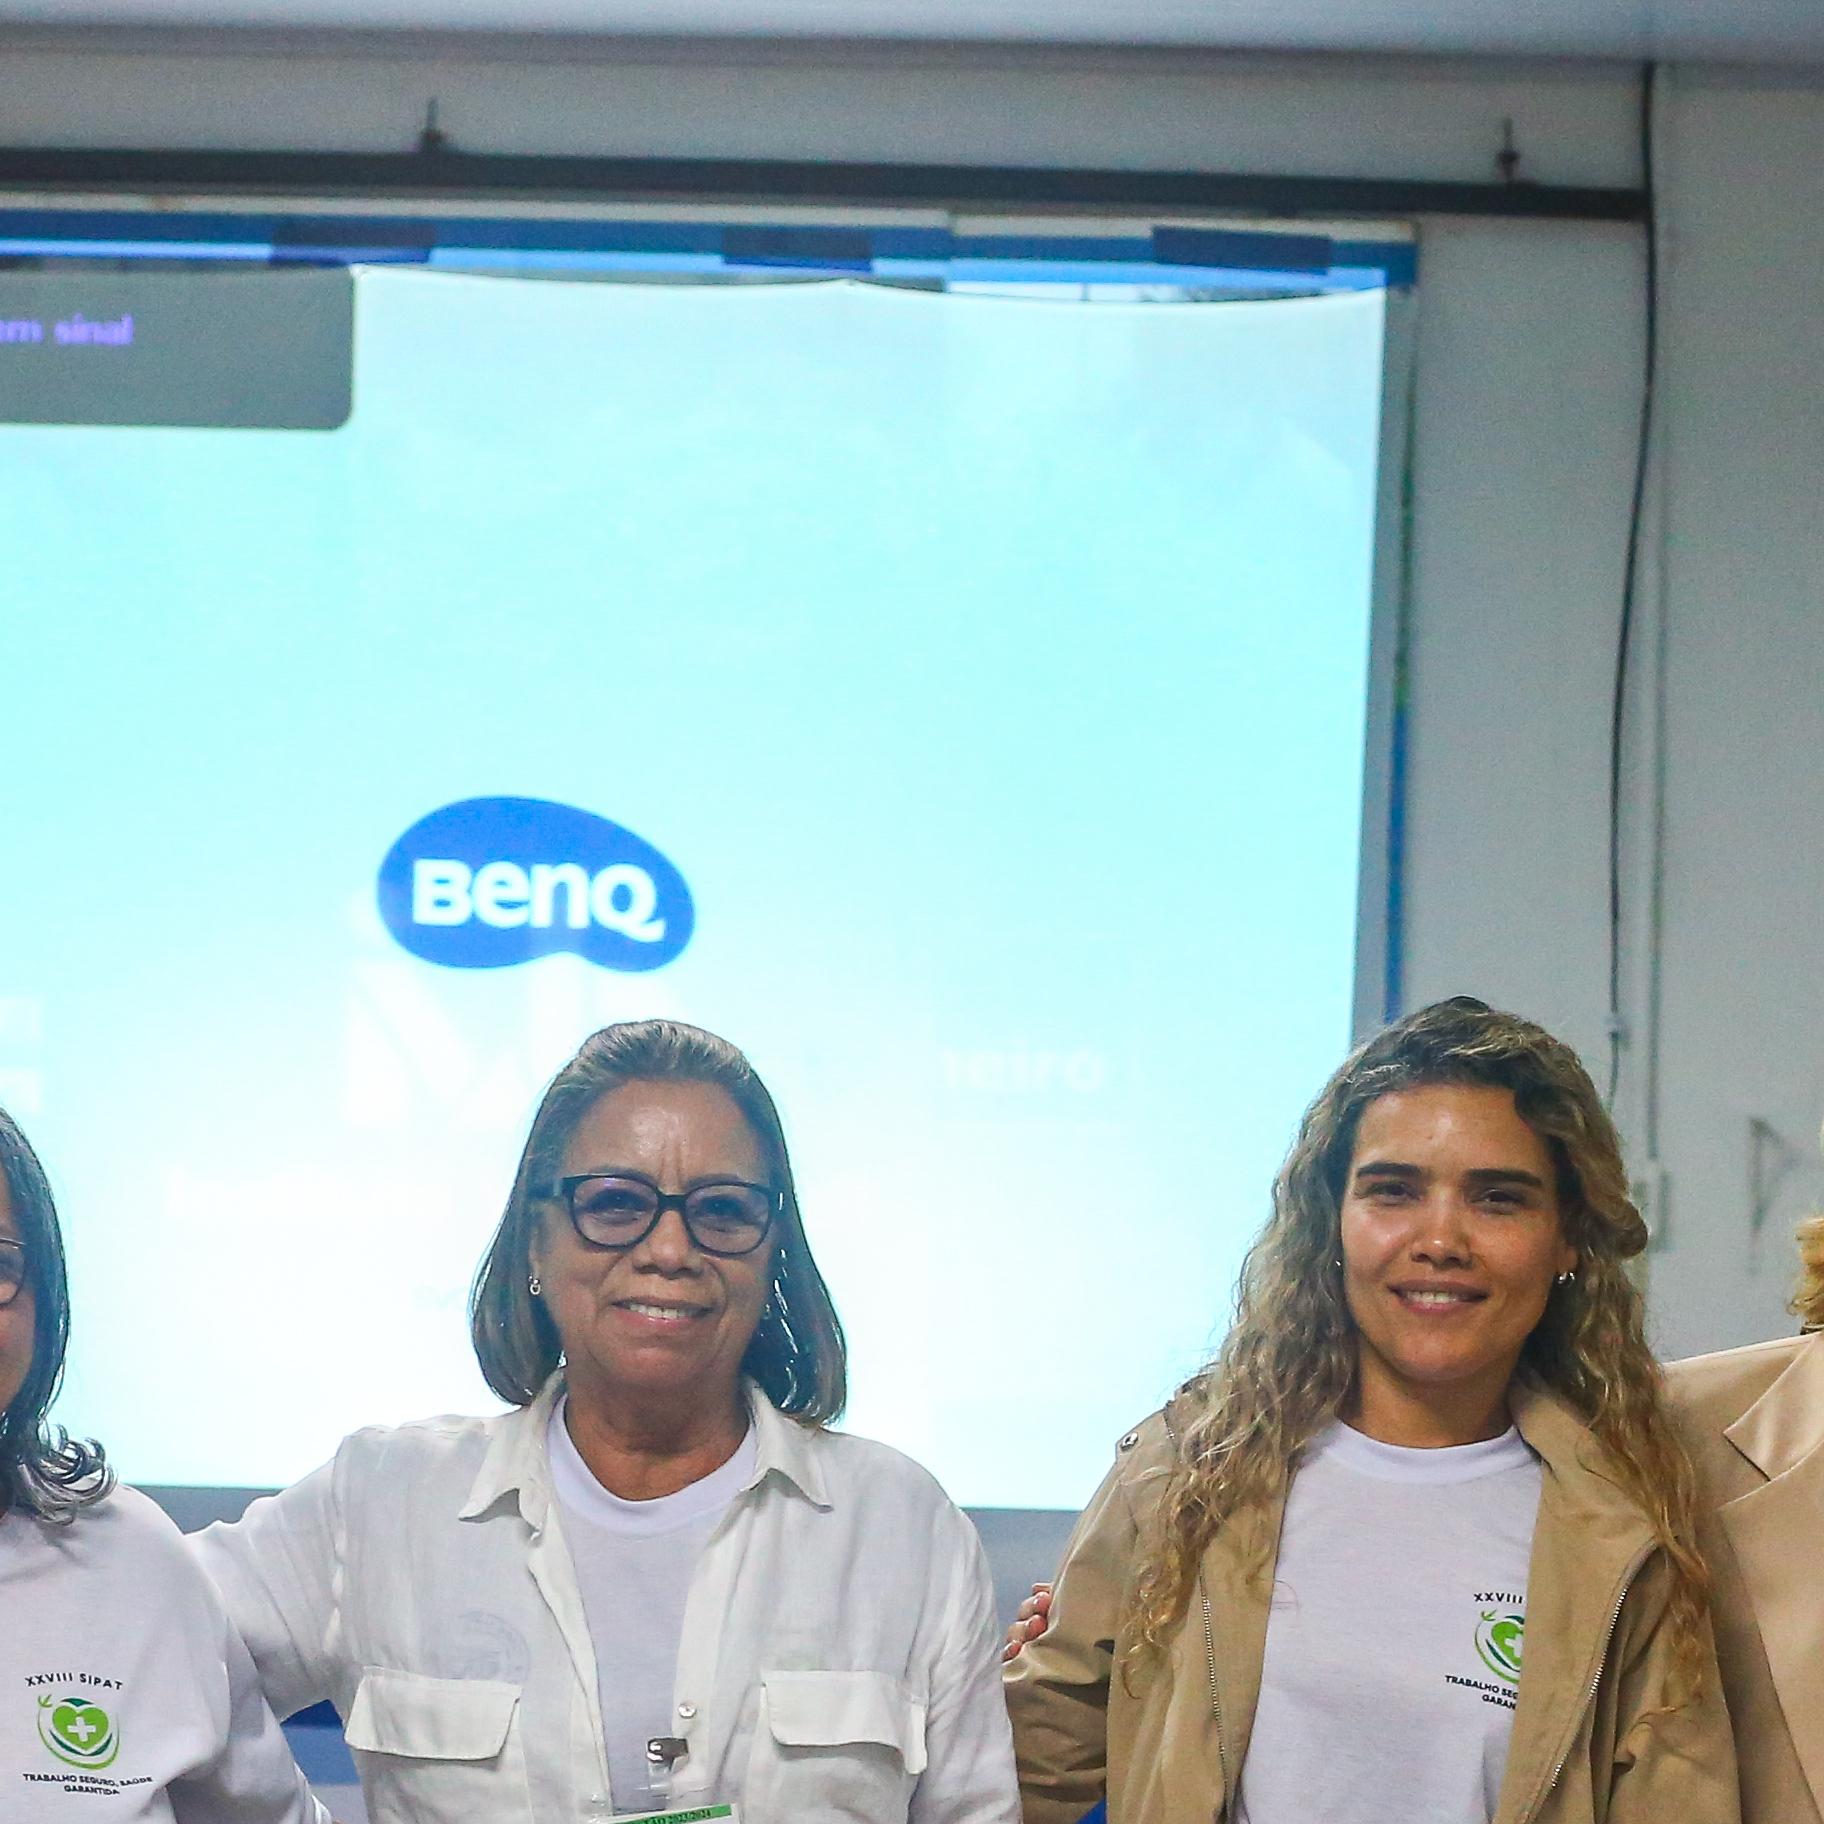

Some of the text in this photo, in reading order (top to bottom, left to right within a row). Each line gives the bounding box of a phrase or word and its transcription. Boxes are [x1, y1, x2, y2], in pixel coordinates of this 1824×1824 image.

[54, 313, 135, 346] sinal
[411, 857, 668, 944] BenQ
[1474, 1592, 1523, 1604] XXVIII
[24, 1672, 124, 1690] XXVIII SIPAT
[1445, 1675, 1499, 1693] TRABALHO
[22, 1773, 76, 1783] TRABALHO
[64, 1785, 121, 1796] GARANTIDA
